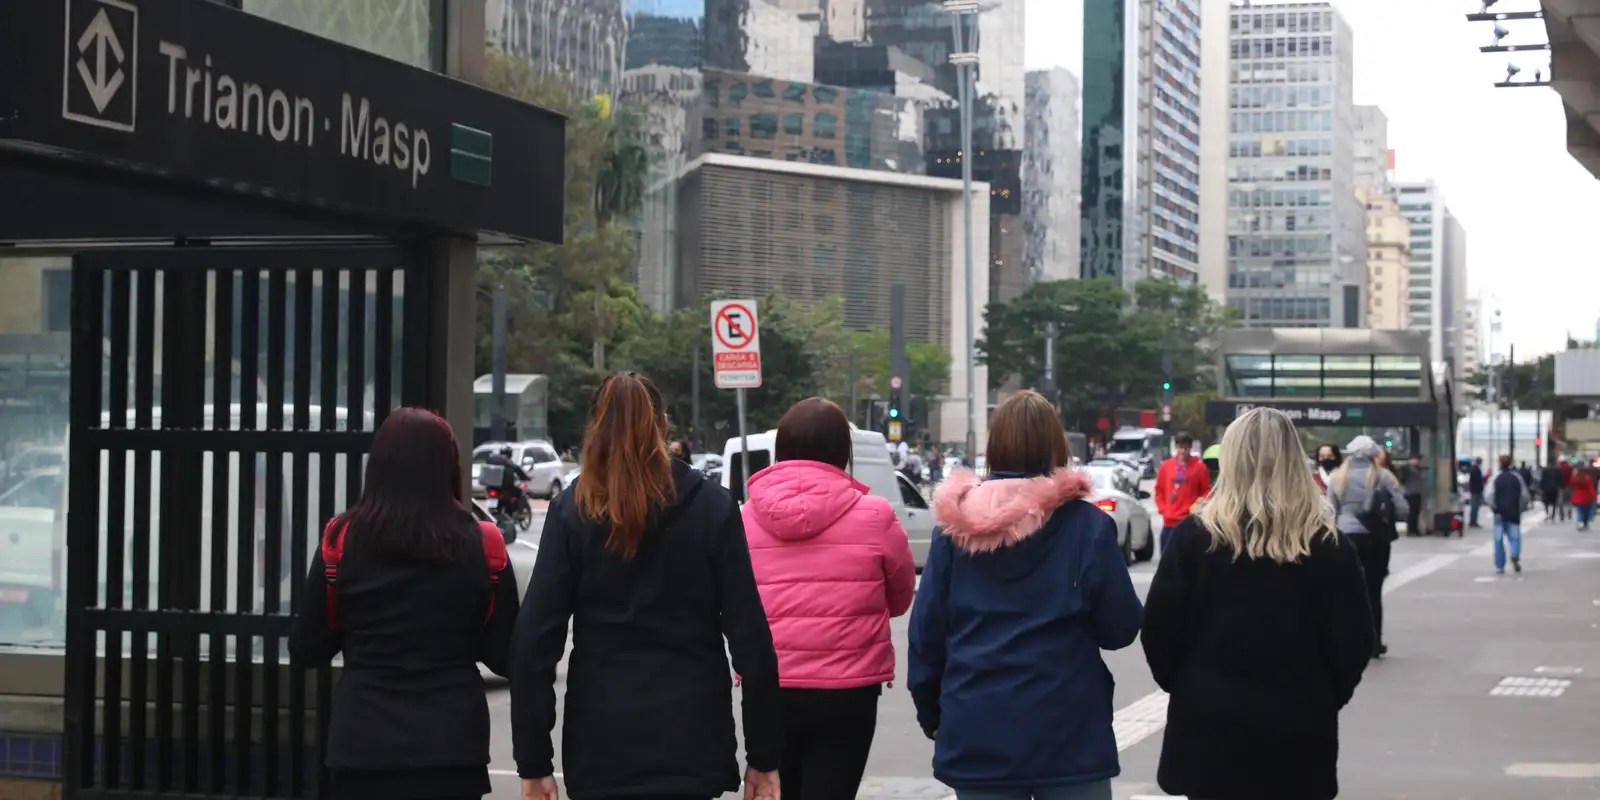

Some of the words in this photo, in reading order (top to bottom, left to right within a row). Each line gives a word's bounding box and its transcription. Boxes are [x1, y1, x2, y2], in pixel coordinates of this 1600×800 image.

[159, 40, 314, 147] Trianon
[341, 92, 430, 189] Masp
[728, 314, 742, 338] E
[1308, 407, 1342, 423] Masp
